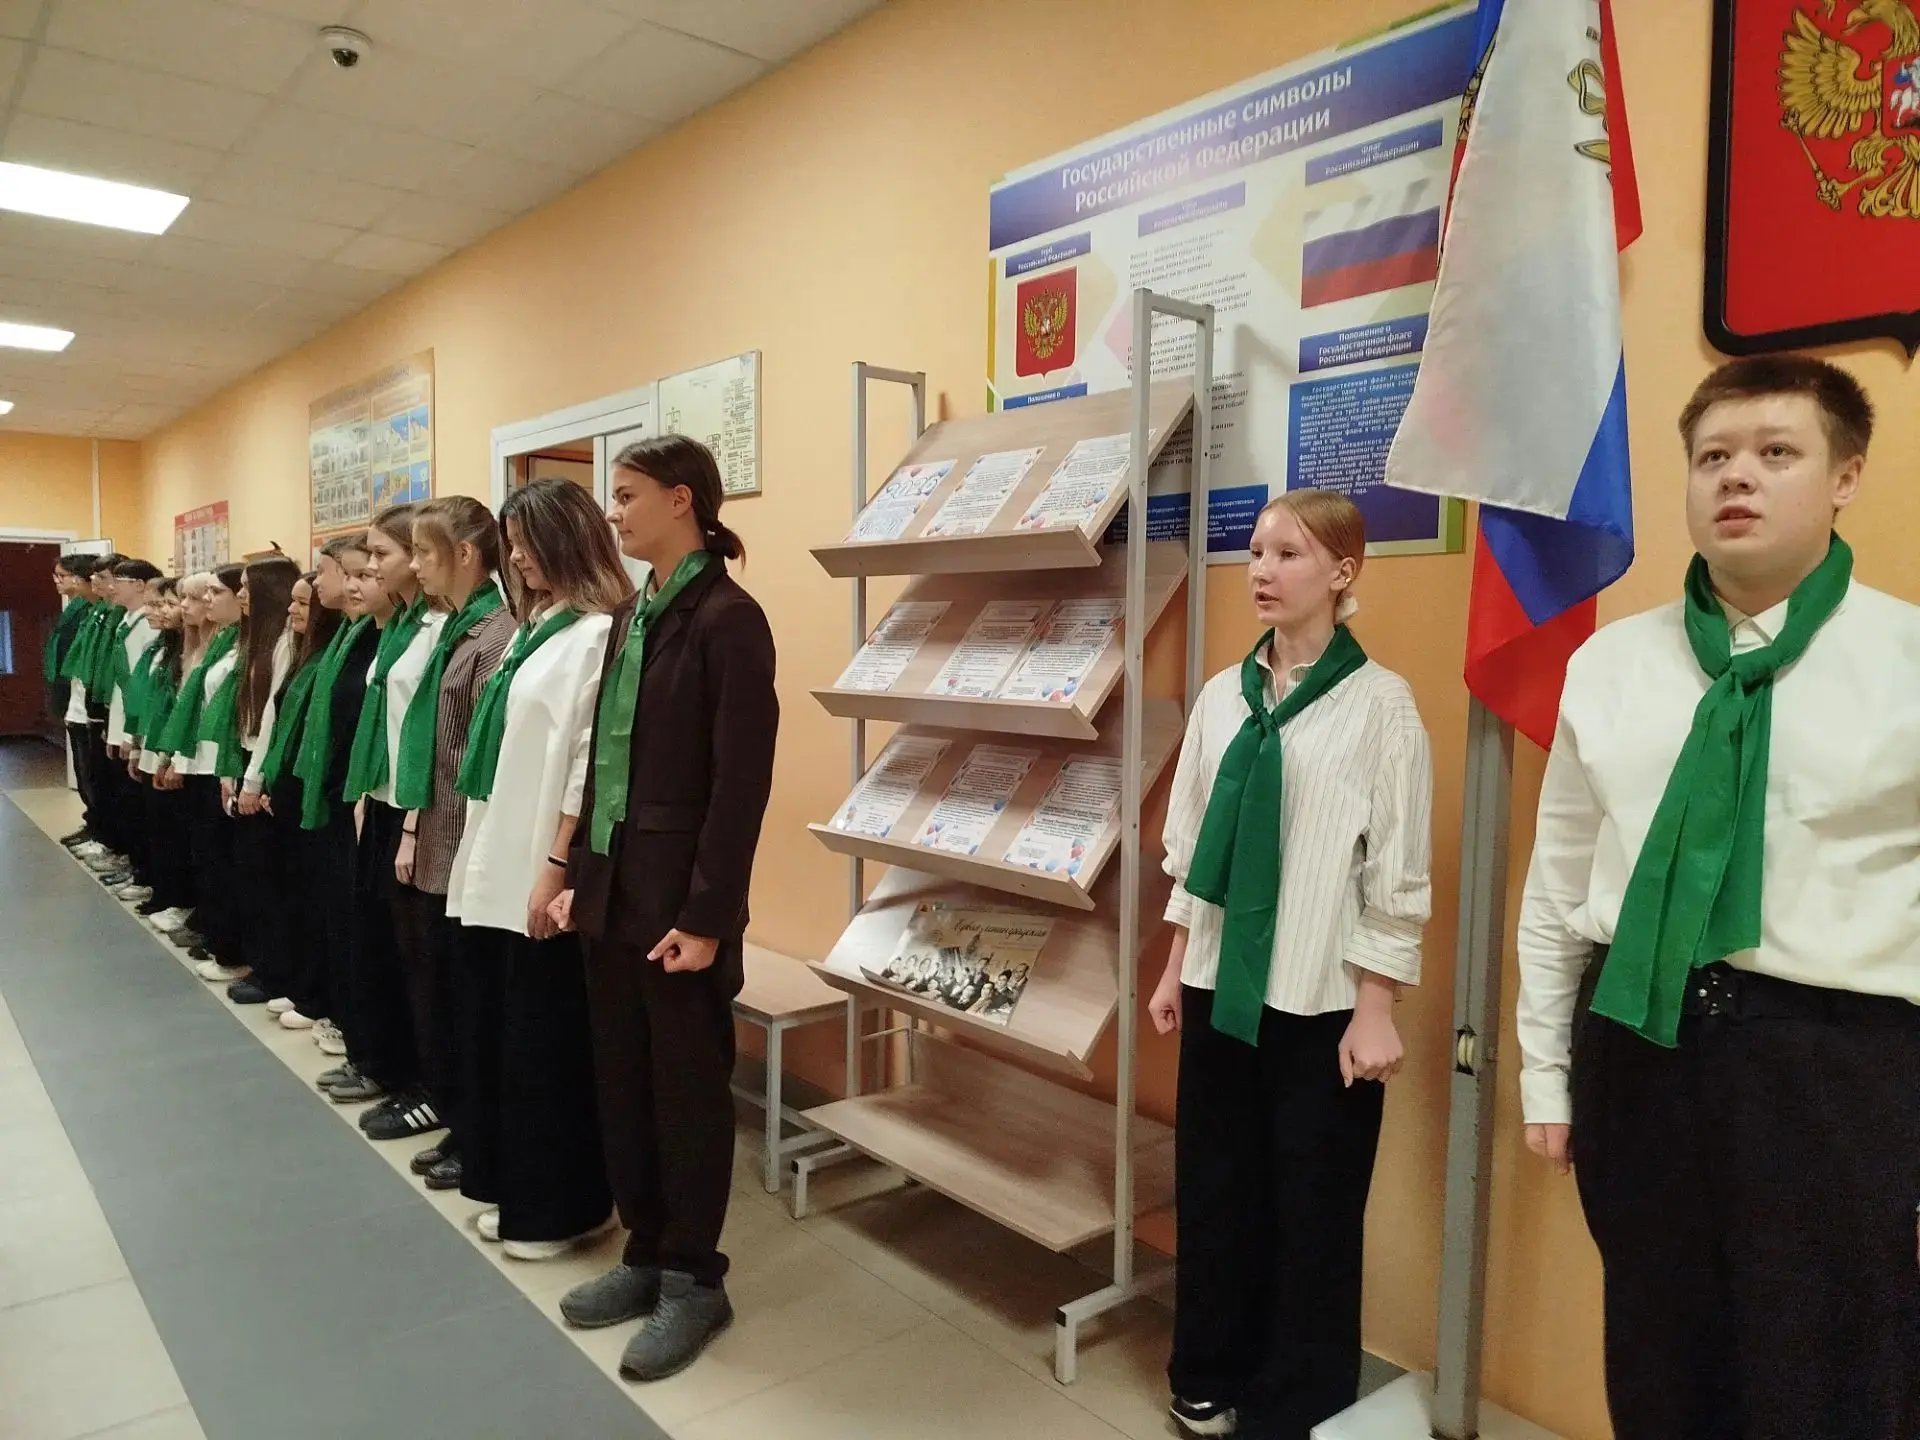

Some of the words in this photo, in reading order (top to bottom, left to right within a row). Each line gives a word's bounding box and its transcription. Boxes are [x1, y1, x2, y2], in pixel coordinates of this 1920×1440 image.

[1062, 110, 1237, 189] Государственные
[1242, 66, 1352, 122] символы
[1075, 154, 1190, 212] Российской
[1198, 108, 1330, 170] Федерации
[1339, 326, 1384, 342] Положение
[1385, 325, 1391, 333] о
[1387, 330, 1412, 343] флаге
[1319, 348, 1364, 366] Российской
[1365, 341, 1412, 357] Федерации
